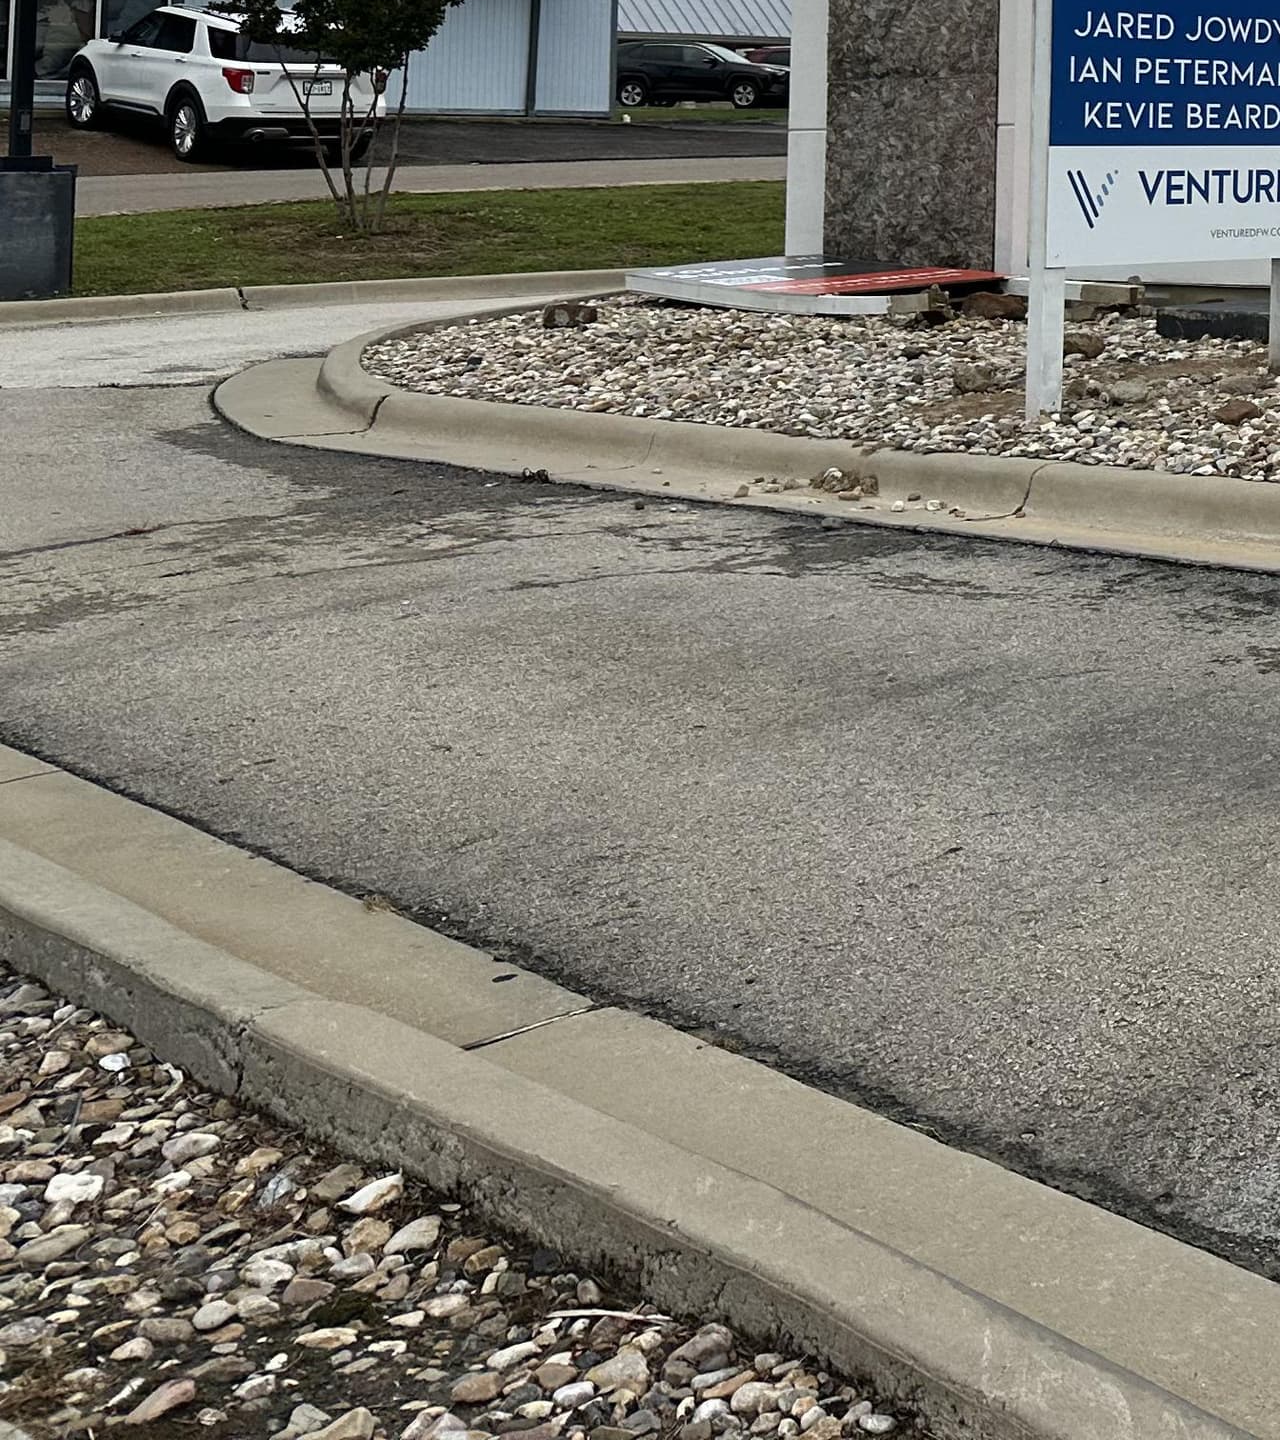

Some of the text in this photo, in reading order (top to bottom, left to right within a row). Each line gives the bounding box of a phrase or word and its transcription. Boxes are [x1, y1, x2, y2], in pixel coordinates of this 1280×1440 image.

[1074, 11, 1175, 40] JARED
[1069, 56, 1122, 83] IAN
[1084, 101, 1280, 129] KEVIE BEARD
